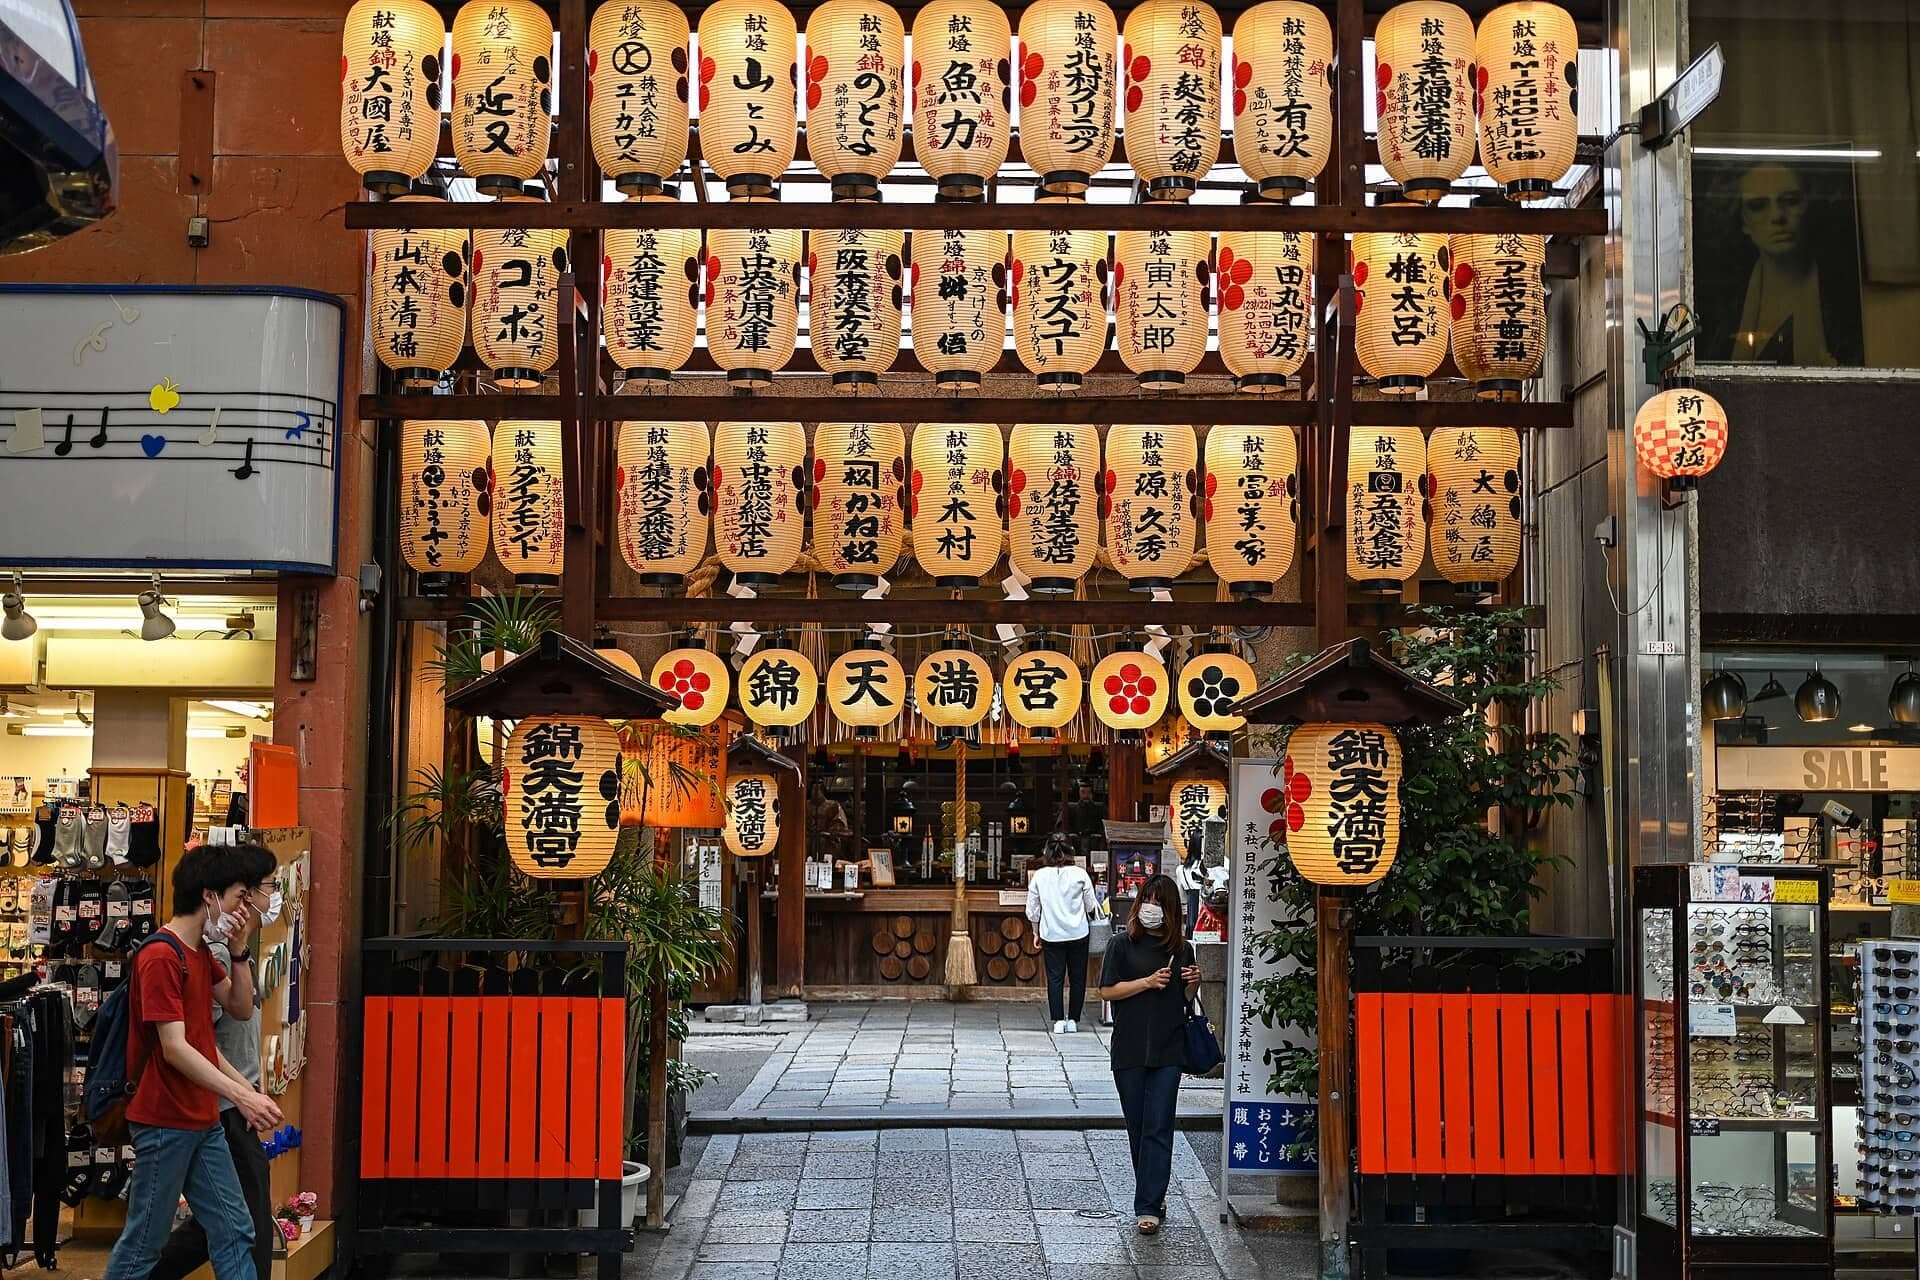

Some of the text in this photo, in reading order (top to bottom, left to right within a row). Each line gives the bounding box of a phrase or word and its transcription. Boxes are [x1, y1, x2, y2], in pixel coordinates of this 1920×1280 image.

[477, 48, 492, 65] 宿
[484, 6, 512, 40] 献燈
[618, 6, 647, 40] 献燈
[1176, 43, 1206, 69] 錦
[1178, 6, 1207, 40] 献燈
[1513, 20, 1538, 57] 献燈
[362, 11, 397, 153] 献燈 錦 大國屋
[399, 50, 414, 141] うなぎ川魚専門
[637, 75, 659, 139] 株式会社
[733, 14, 777, 153] 献燈 山とみ
[848, 14, 886, 156] 献燈 錦 のとよ
[886, 67, 899, 141] 川魚専門店
[939, 15, 982, 150] 献燈 魚力
[976, 58, 995, 149] 鮮魚 焼物
[1062, 11, 1103, 154] 献燈 北村クリニック
[1273, 17, 1313, 157] 献燈 株式会社 有次
[1307, 59, 1326, 87] 錦
[1410, 17, 1452, 162] 献燈 幸福堂老舗
[1543, 40, 1560, 121] 鉄骨工事一式
[474, 76, 516, 156] 近又
[614, 83, 641, 163] エーカワベ
[390, 238, 422, 358] 山本清掃
[735, 253, 780, 353] 中央信用金庫
[776, 259, 791, 300] 京都
[938, 258, 967, 275] 錦
[970, 266, 988, 341] 京つけもの
[1080, 259, 1094, 330] 寺町錦上ル
[1253, 286, 1268, 298] 電
[1386, 252, 1427, 346] 権太呂
[723, 274, 739, 341] 四条支店
[834, 248, 871, 361] 阪本漢方堂
[1040, 257, 1081, 356] ウィズユー
[1143, 258, 1177, 353] 寅太郎
[1266, 265, 1305, 361] 田丸印房
[1493, 261, 1530, 361] アキヤマ歯科
[423, 429, 445, 464] 献燈
[746, 427, 769, 462] 献燈
[845, 424, 875, 458] 献燈
[1053, 431, 1075, 467] 献燈
[1243, 435, 1265, 471] 献燈
[1454, 431, 1482, 462] 献燈
[1674, 395, 1706, 469] 新京極
[507, 430, 546, 559] 献燈 ダイアモンド
[637, 428, 675, 560] 献燈 積水ハウス株式会社
[775, 465, 788, 523] 寺町錦角
[879, 470, 895, 536] 京野菜
[936, 430, 977, 561] 献燈 鮮魚 木村
[969, 468, 991, 493] 錦
[1133, 432, 1169, 562] 献燈 源久秀
[1267, 477, 1287, 508] 錦
[1366, 435, 1402, 569] 献燈 五感食楽
[841, 492, 882, 565] かね松
[1043, 480, 1082, 564] 佐竹生花店
[747, 658, 1068, 712] 錦 天 満 宮
[521, 722, 584, 868] 錦天満宮
[1328, 729, 1389, 875] 錦天満宮
[1802, 750, 1889, 790] SALE
[734, 777, 766, 850] 錦天満宮
[1233, 1107, 1250, 1160] 腹帯
[1257, 1107, 1272, 1163] おみくじ
